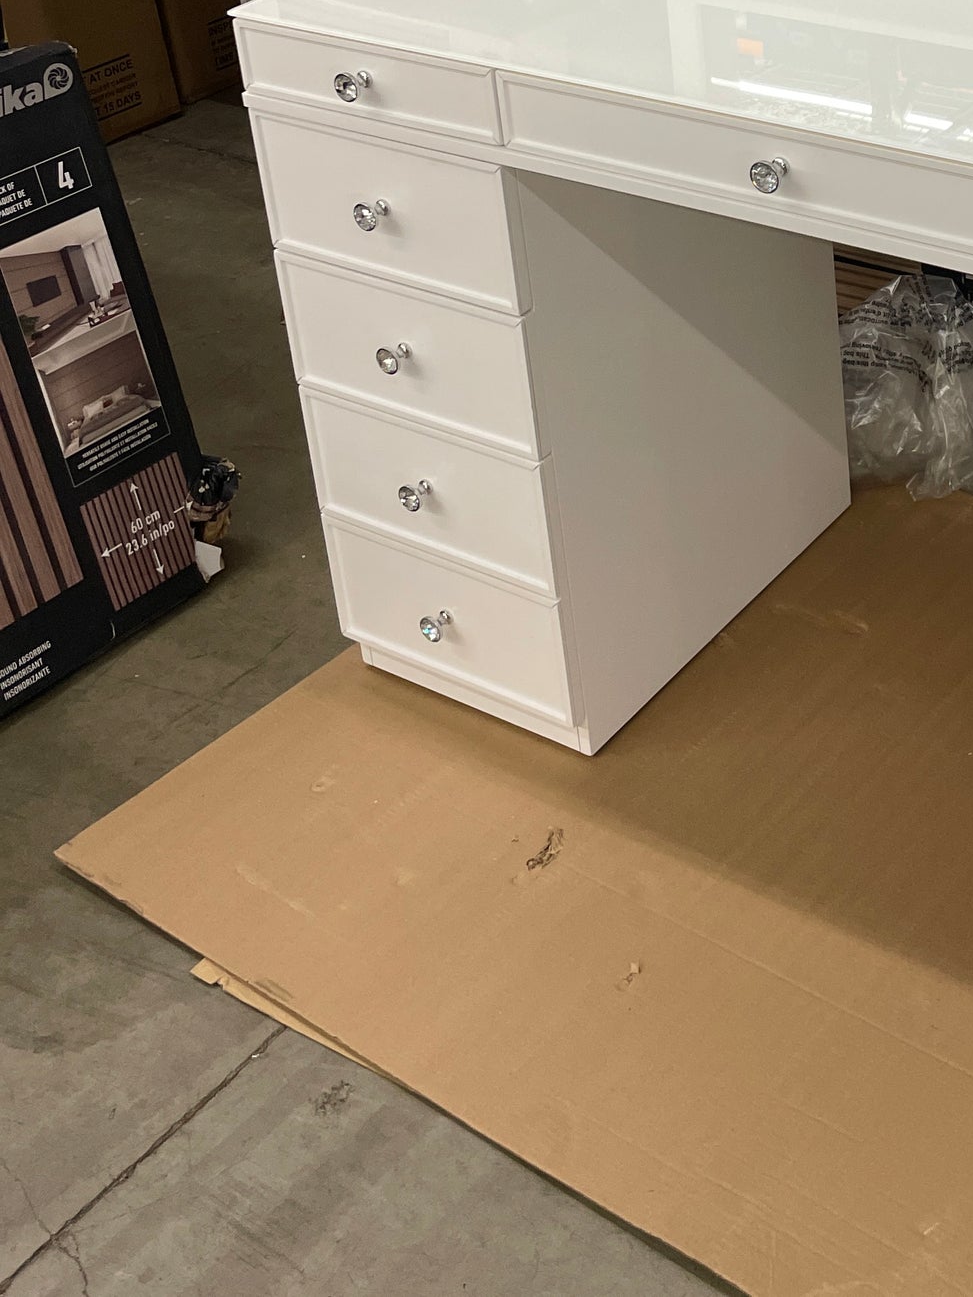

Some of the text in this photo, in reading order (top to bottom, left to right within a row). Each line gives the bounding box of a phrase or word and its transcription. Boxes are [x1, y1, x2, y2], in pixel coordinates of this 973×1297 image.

[89, 59, 134, 85] AT ONCE
[105, 102, 115, 114] 15
[116, 91, 142, 108] DAYS
[7, 181, 15, 191] OF
[57, 160, 75, 190] 4
[17, 189, 26, 199] DE
[24, 197, 33, 208] DE
[130, 509, 161, 534] 60 cm
[125, 519, 176, 557] 23.6 in/po
[18, 640, 52, 667] ABSORBING
[0, 657, 44, 690] INSONORISANT
[3, 665, 52, 701] INSONORIZANTE
